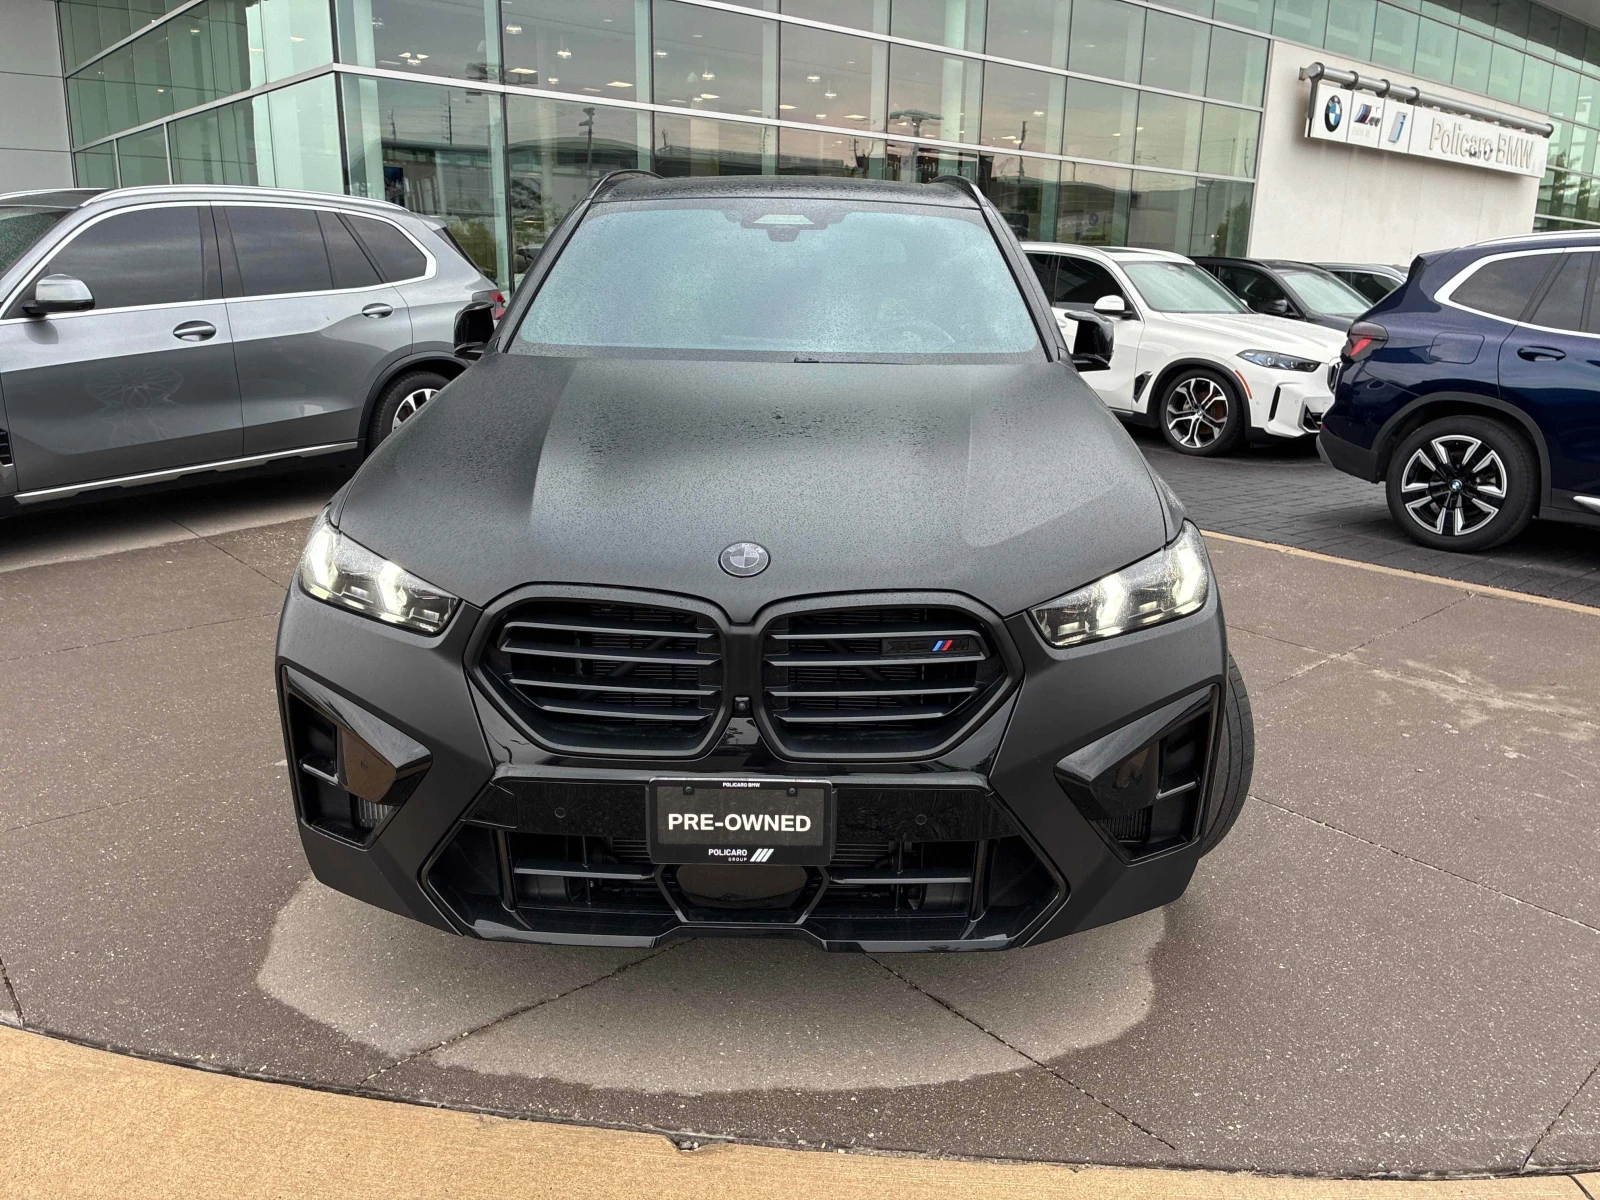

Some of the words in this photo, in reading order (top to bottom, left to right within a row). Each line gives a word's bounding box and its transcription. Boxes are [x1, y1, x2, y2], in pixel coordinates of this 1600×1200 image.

[1429, 117, 1493, 162] Policaro
[1496, 133, 1534, 169] BMW
[668, 813, 812, 832] PRE-OWNED
[708, 848, 748, 857] POLICARO
